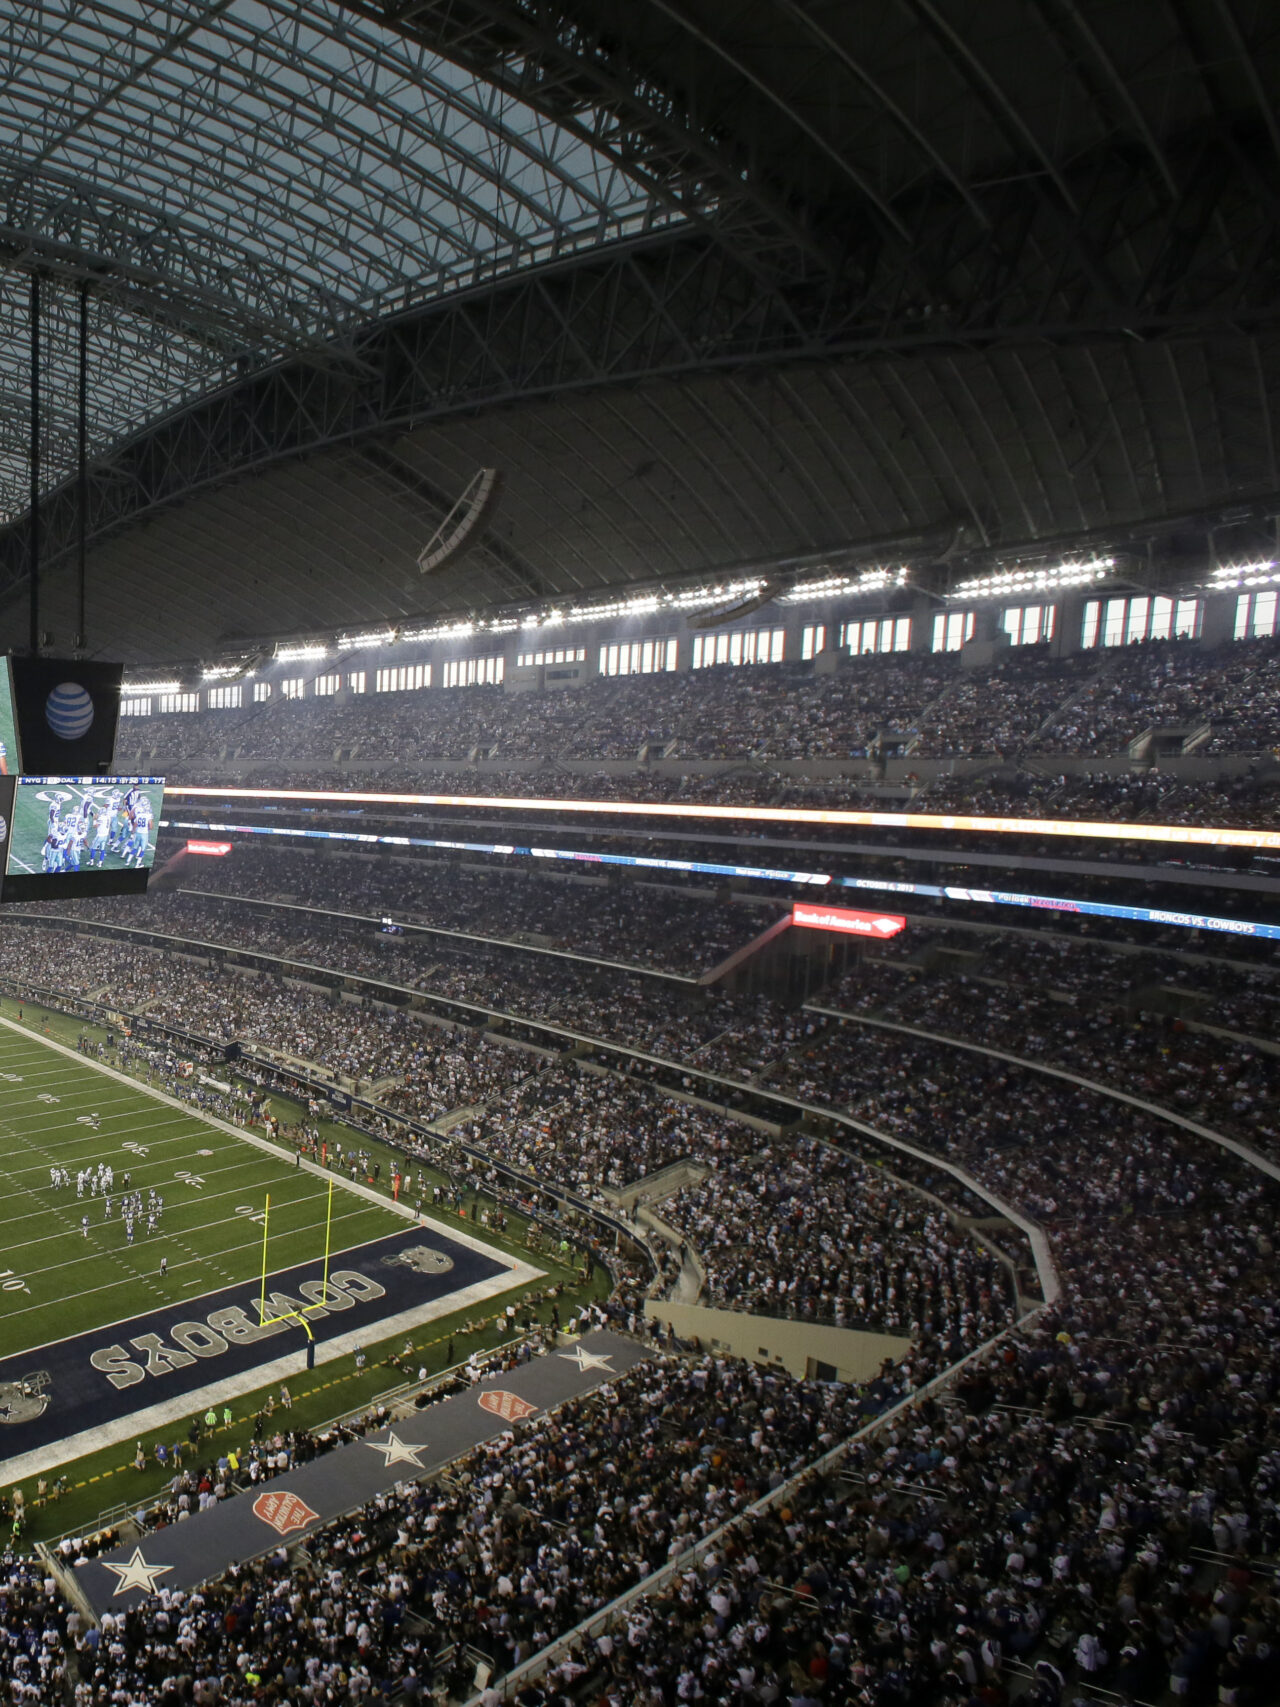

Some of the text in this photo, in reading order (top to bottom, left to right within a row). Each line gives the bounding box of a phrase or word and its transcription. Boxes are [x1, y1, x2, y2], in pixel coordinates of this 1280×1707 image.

[1190, 830, 1218, 844] why
[1221, 833, 1263, 847] every
[856, 879, 889, 889] OCTOBER
[795, 911, 872, 931] Bank of America
[1149, 910, 1256, 933] BRONCOS VS. COWBOYS
[174, 1170, 206, 1185] 20
[235, 1205, 266, 1221] 10
[90, 1270, 386, 1390] COWBOYS
[263, 1494, 280, 1519] ARMY
[273, 1494, 297, 1529] SALVATION
[291, 1507, 306, 1525] THE
